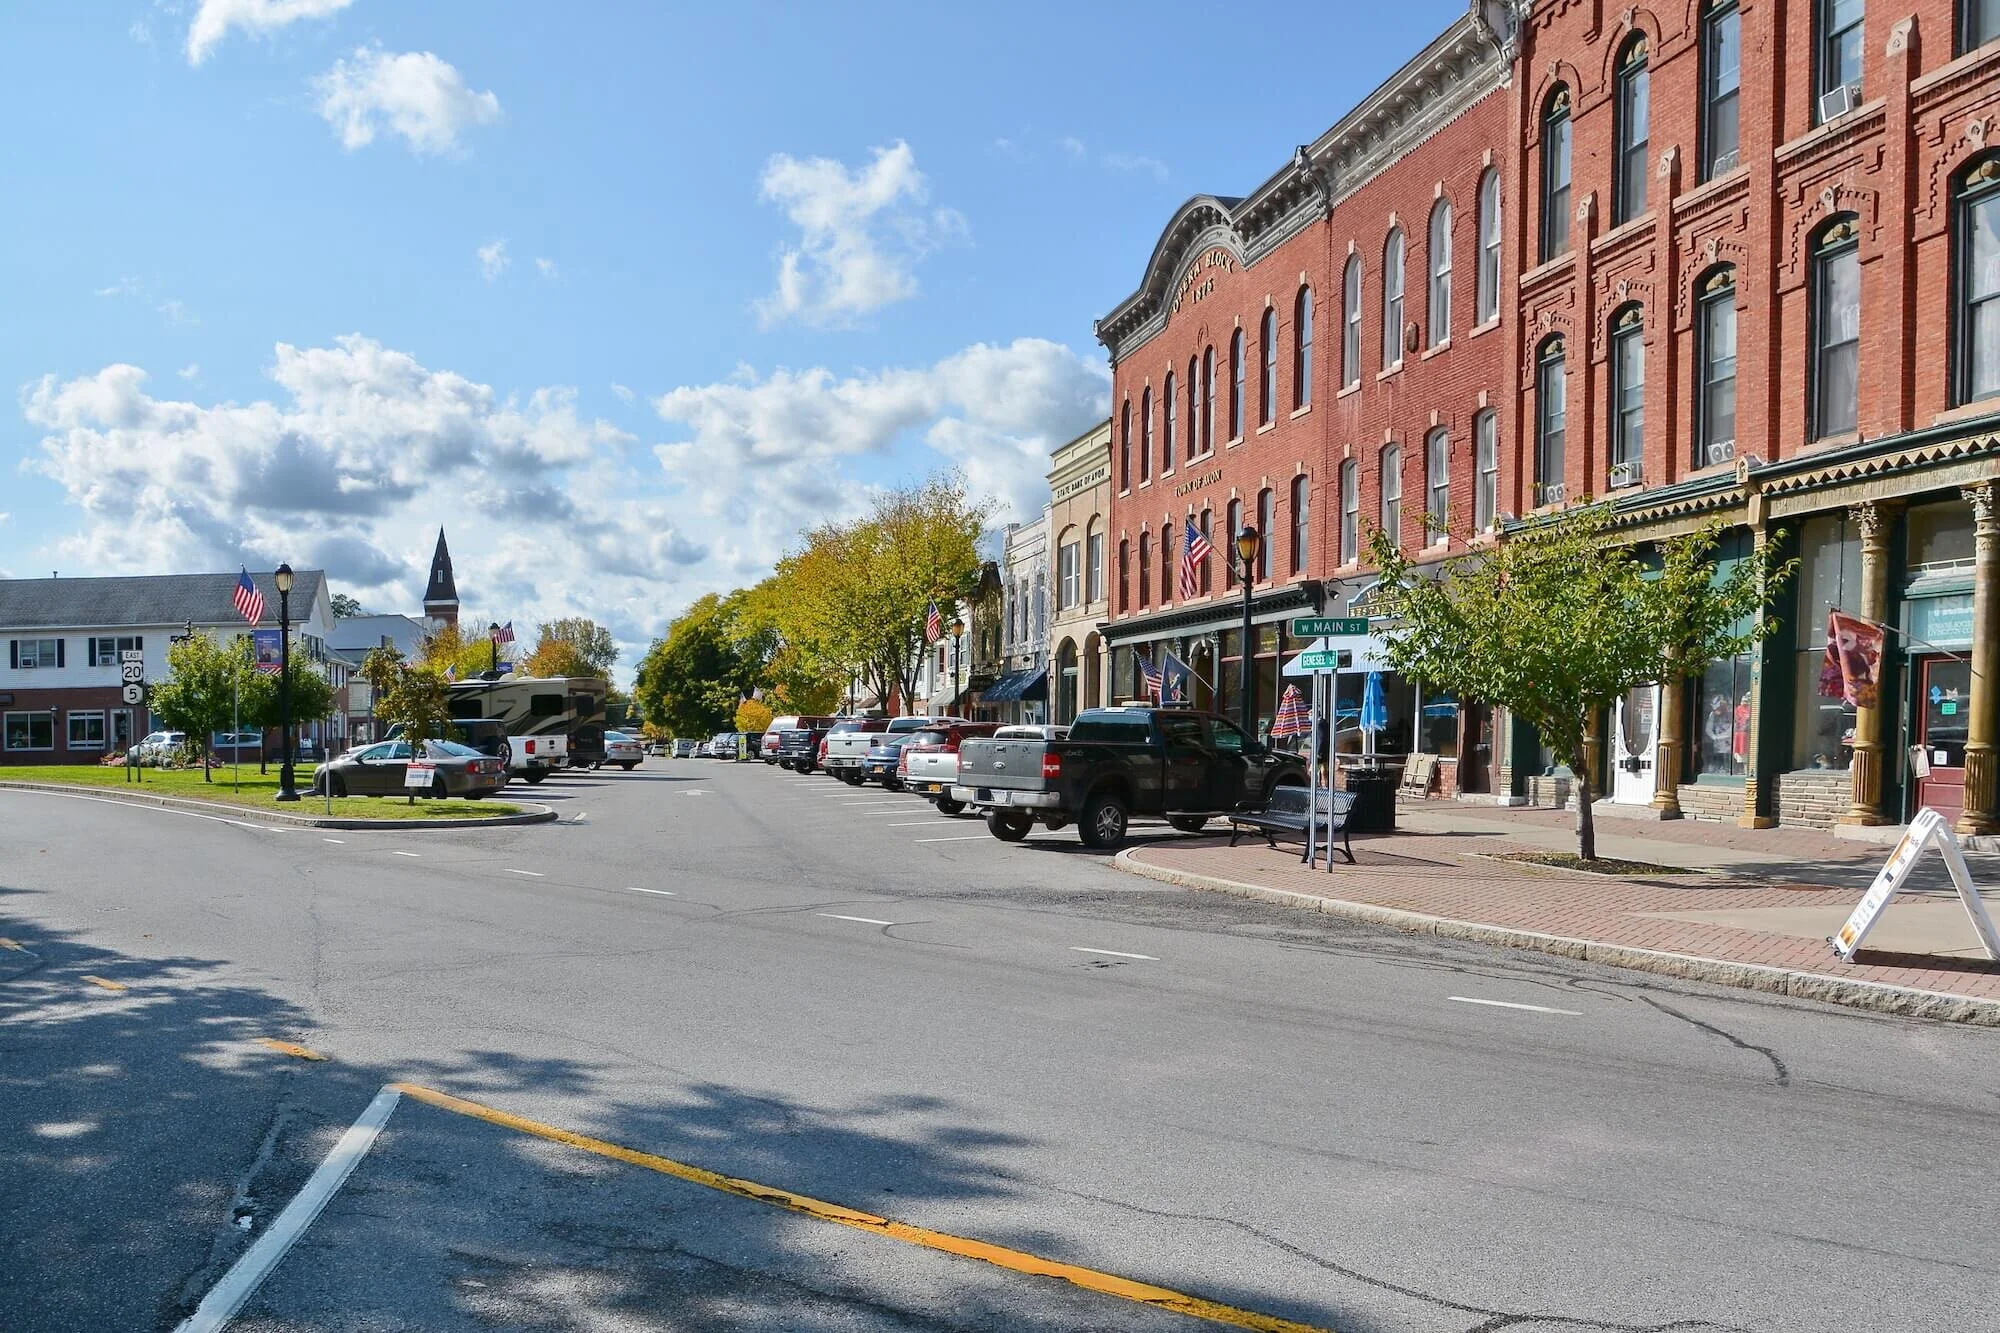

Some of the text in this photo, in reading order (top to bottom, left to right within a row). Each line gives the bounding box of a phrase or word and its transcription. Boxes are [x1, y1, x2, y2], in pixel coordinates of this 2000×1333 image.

[1172, 250, 1234, 313] OPERA BLOCK
[1301, 621, 1361, 633] W MAIN ST
[125, 651, 139, 659] EAST
[124, 666, 141, 678] 20
[129, 688, 137, 700] 5
